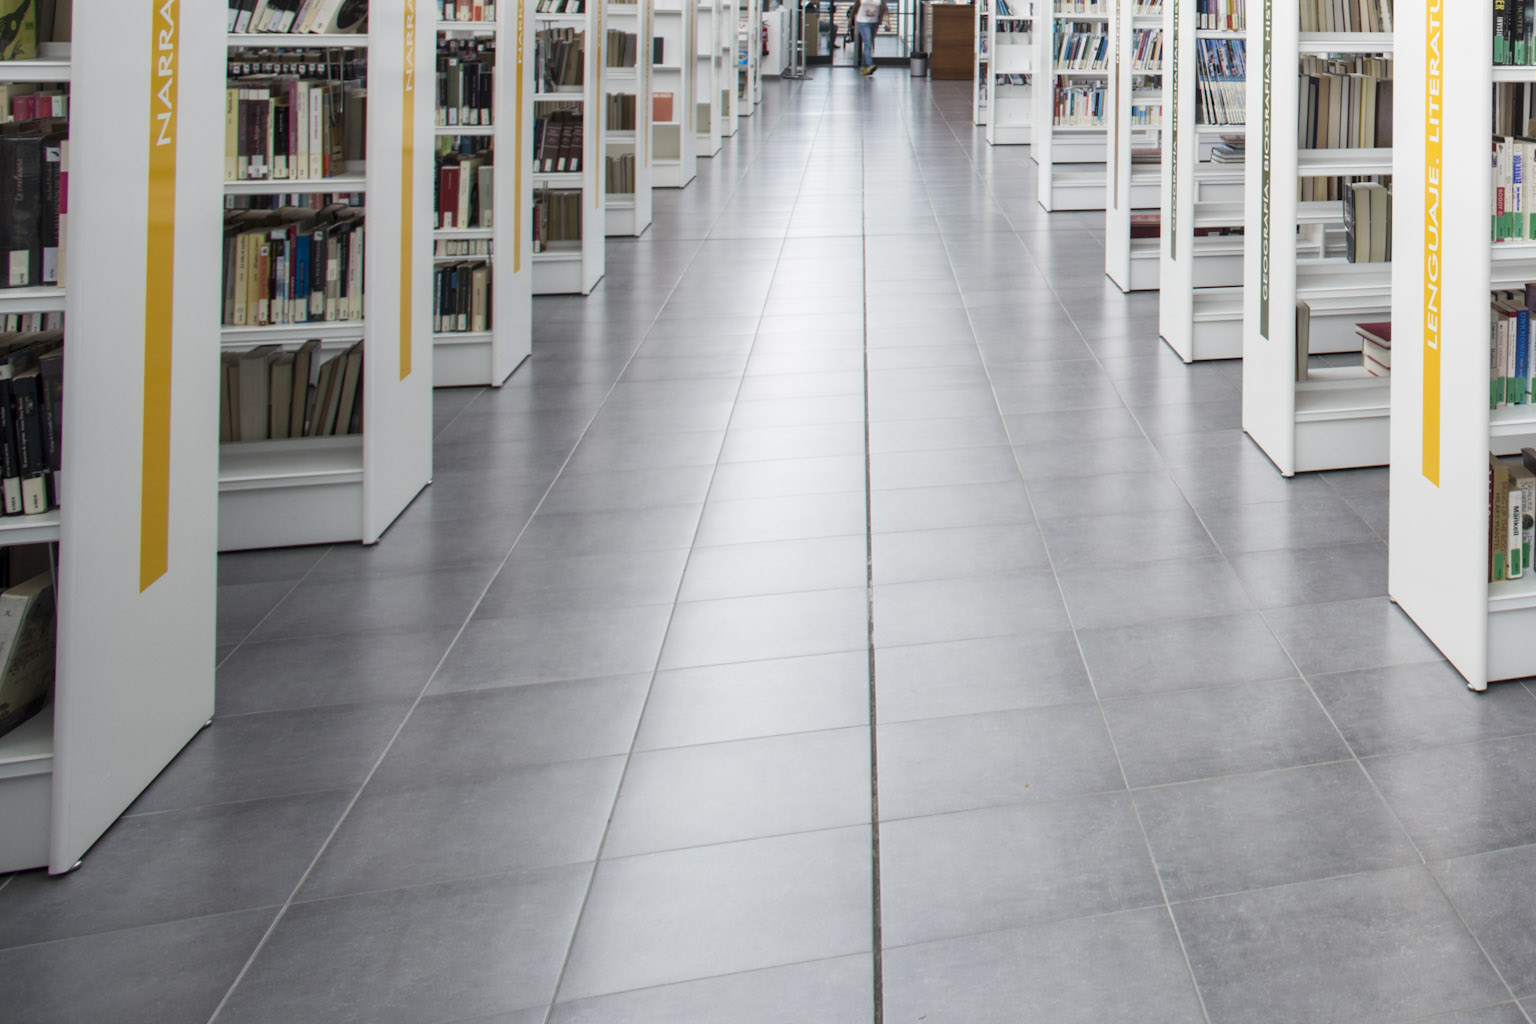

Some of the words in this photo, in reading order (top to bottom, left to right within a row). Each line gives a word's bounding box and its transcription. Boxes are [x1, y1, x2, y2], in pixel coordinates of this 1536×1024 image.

[1496, 16, 1504, 36] INVISI
[1263, 48, 1271, 171] BIOGRAFÍAS.
[1262, 178, 1271, 301] GEOGRAFÍA.
[1425, 157, 1440, 350] LENGUAJE.
[1519, 311, 1527, 357] UNKNOWN
[1512, 506, 1520, 536] Mankell
